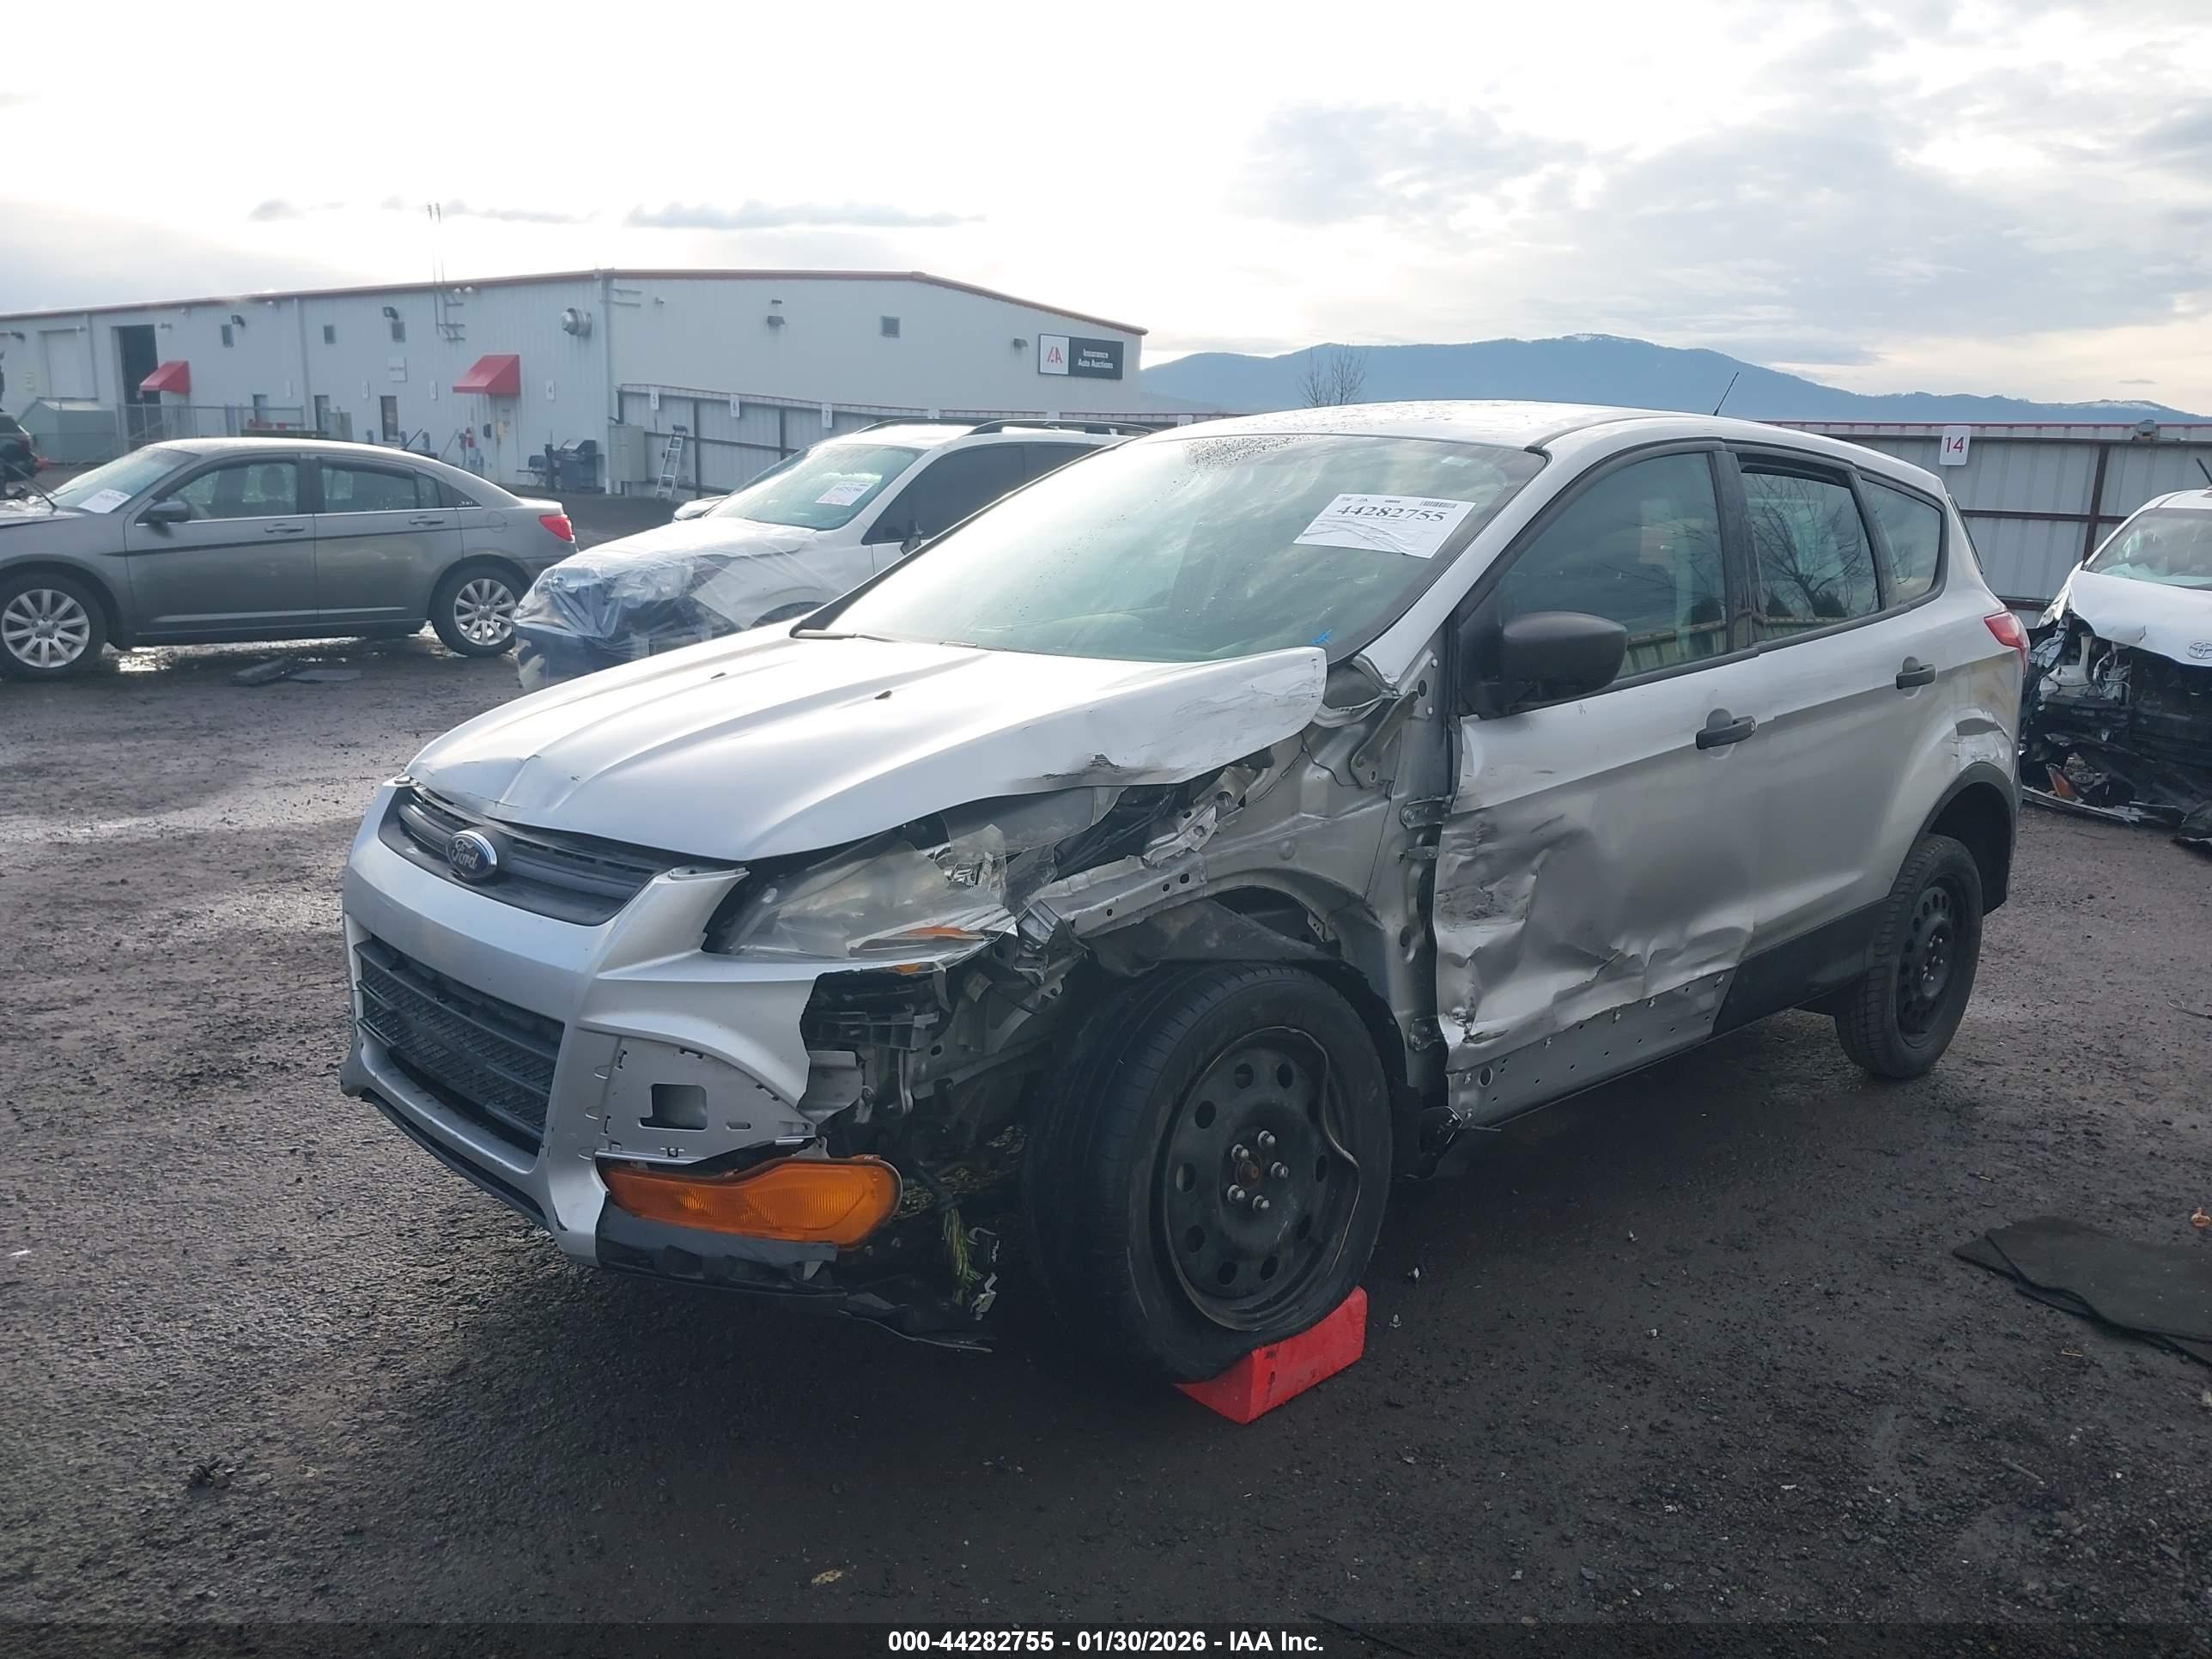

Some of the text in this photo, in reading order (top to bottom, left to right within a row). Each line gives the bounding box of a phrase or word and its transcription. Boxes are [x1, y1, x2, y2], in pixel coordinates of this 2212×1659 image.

[1083, 348, 1109, 359] Insurance
[1078, 358, 1114, 369] Auto Auctions
[1945, 436, 1966, 453] 14
[1336, 505, 1448, 522] 44282755
[452, 838, 479, 870] Ford
